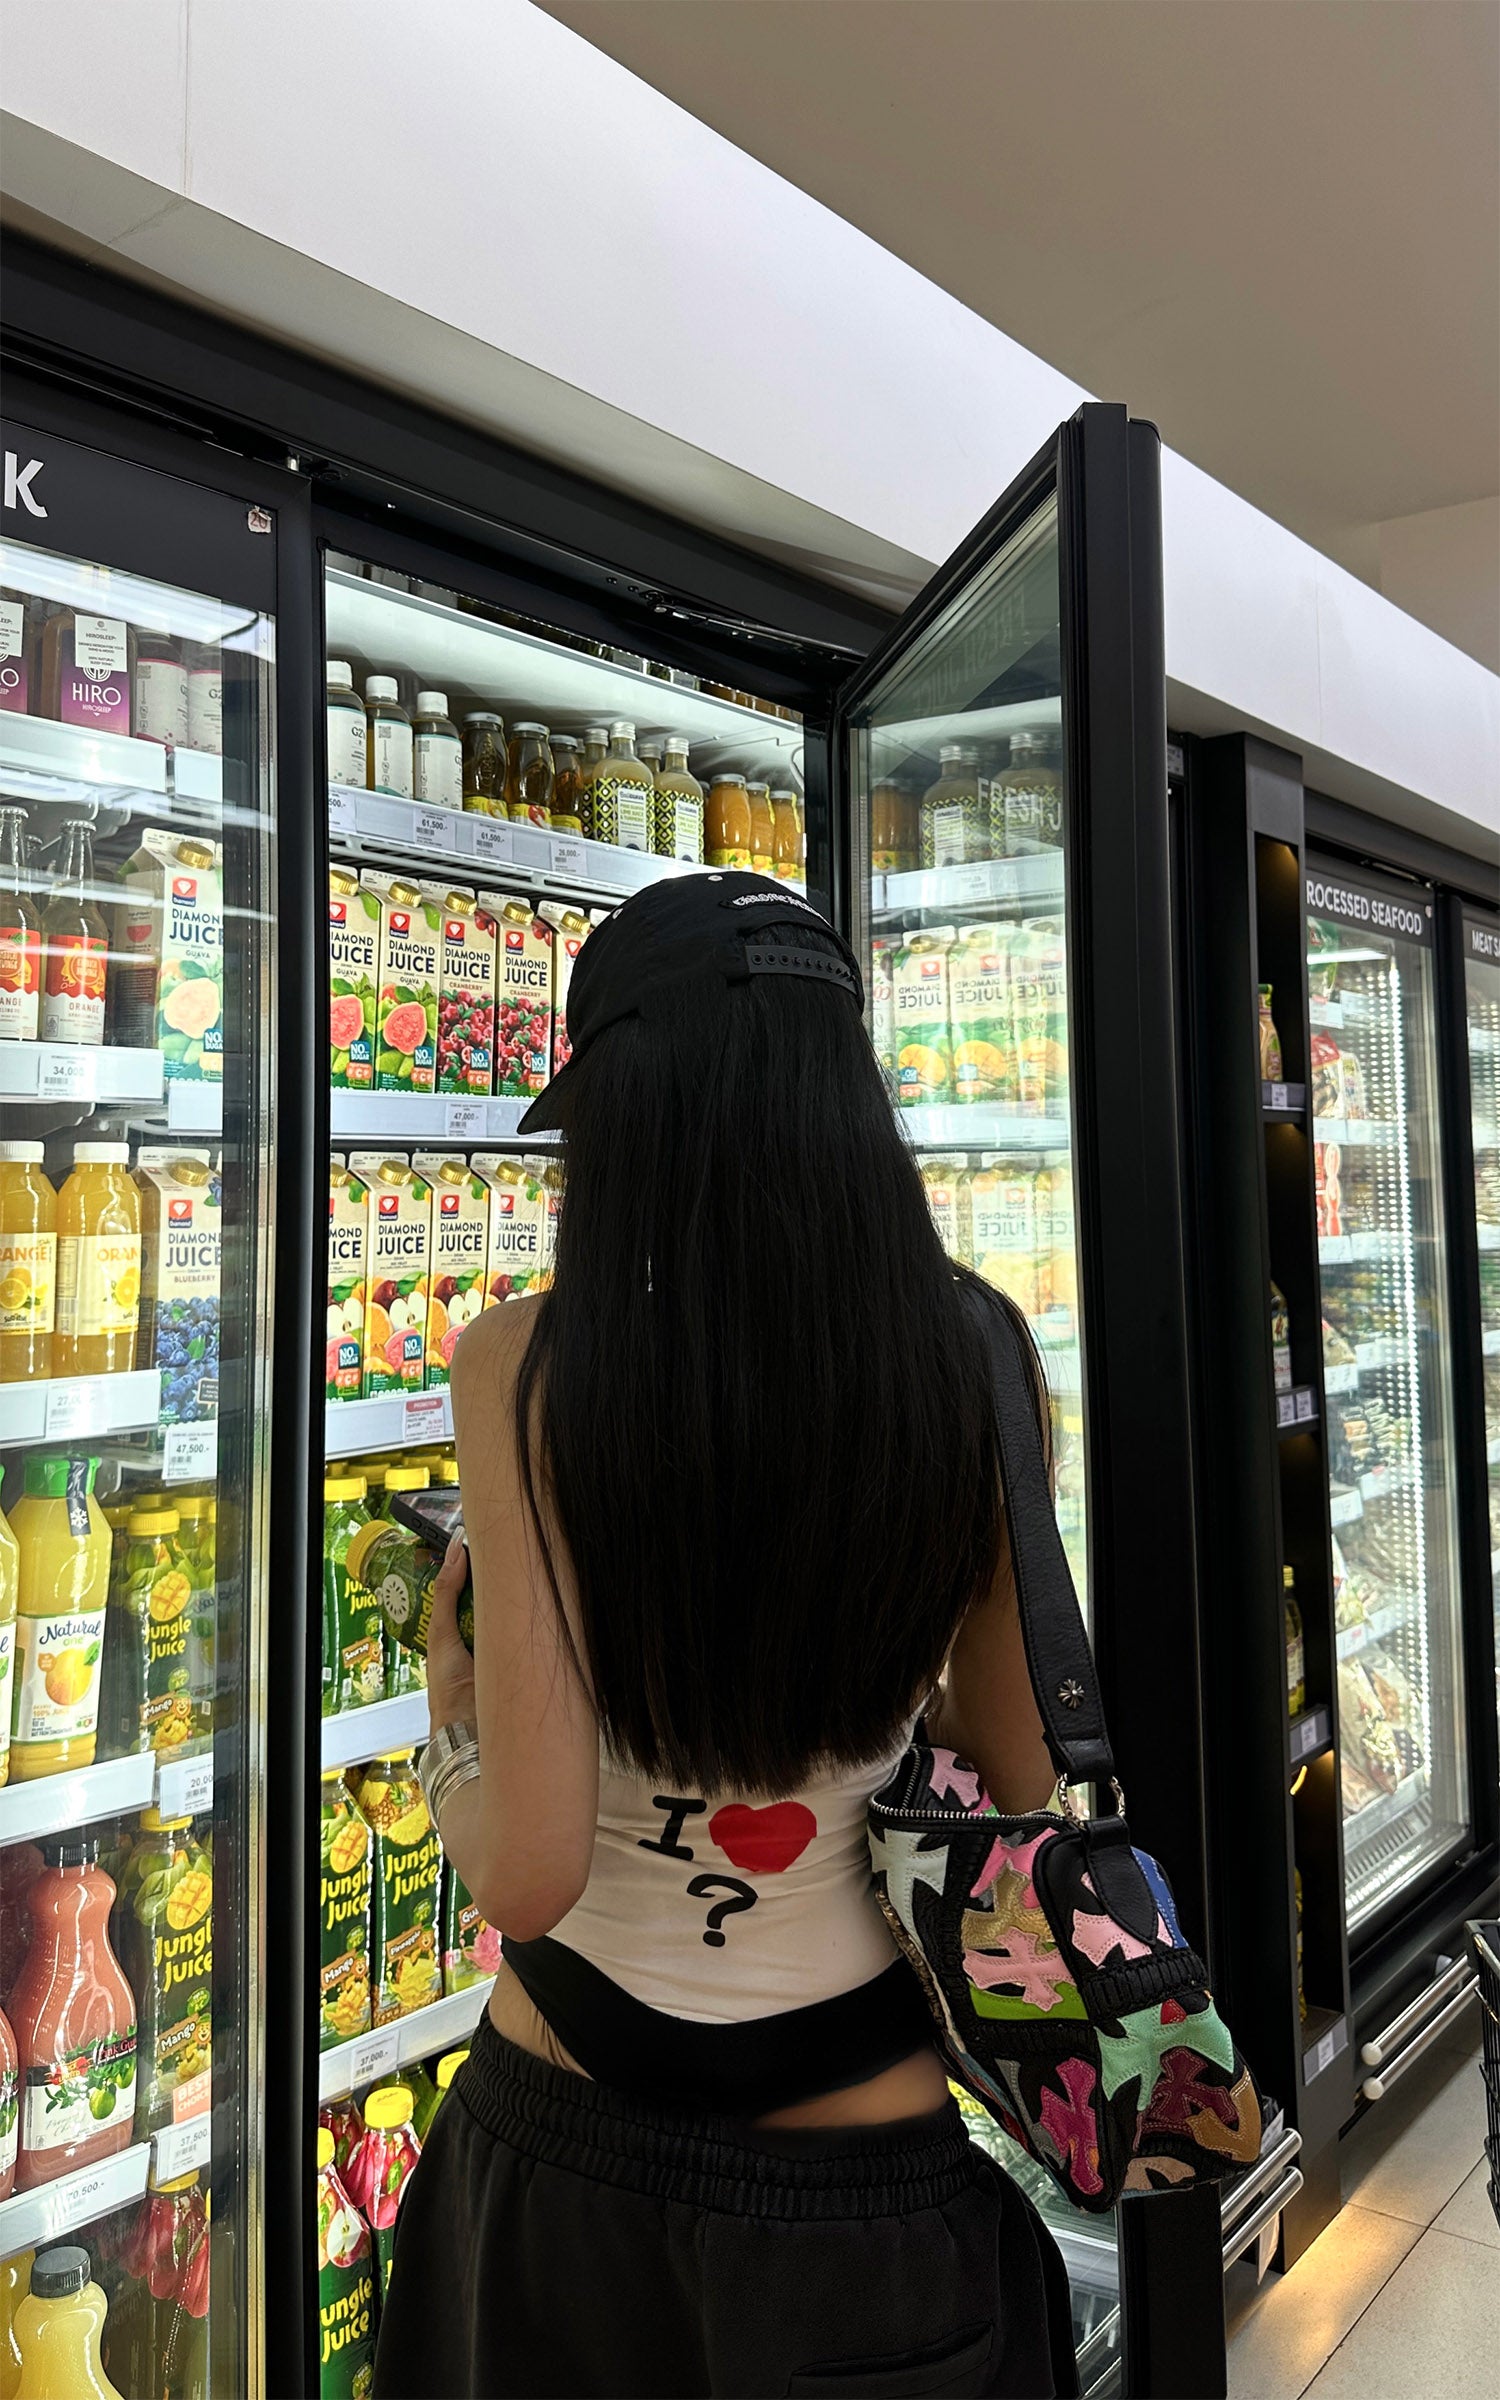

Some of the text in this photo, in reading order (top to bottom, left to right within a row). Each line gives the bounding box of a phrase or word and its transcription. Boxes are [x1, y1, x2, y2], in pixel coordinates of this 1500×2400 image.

[4, 451, 48, 518] K
[72, 682, 121, 706] HIRO
[82, 703, 112, 713] HIROSLEEP
[172, 908, 220, 925] DIAMON
[1306, 880, 1423, 936] ROCESSED SEAFOOD
[388, 940, 435, 956] DIAMOND
[1472, 929, 1493, 954] MEAT
[386, 951, 435, 974] JUICE
[445, 948, 490, 962] DIAMOND
[505, 956, 548, 970] DIAMOND
[336, 968, 358, 976] GUAVA
[443, 959, 490, 980] JUICE
[504, 968, 547, 987] JUICE
[400, 976, 420, 985] GUAVA
[449, 981, 483, 992] CRANBERRY
[509, 989, 541, 998] CRANBERRY
[69, 1002, 100, 1014] ORANGE
[350, 1043, 366, 1054] NO
[414, 1049, 429, 1060] NO
[471, 1052, 484, 1062] NO
[531, 1056, 544, 1066] NO
[378, 1224, 426, 1235] DIAMOND
[440, 1222, 483, 1232] DIAMOND
[498, 1222, 538, 1232] DIAMOND
[332, 1240, 362, 1260] ICE
[376, 1236, 424, 1256] JUICE
[438, 1234, 482, 1252] JUICE
[496, 1234, 536, 1252] JUICE
[0, 1246, 48, 1261] ANGE
[166, 1246, 222, 1268] JUICE
[174, 1274, 216, 1284] BLUEBERRY
[339, 1346, 354, 1360] NO
[404, 1338, 418, 1351] NO
[39, 1620, 101, 1645] Natural
[145, 1616, 192, 1644] Jungle
[150, 1638, 186, 1663] Juice
[144, 1698, 173, 1720] Mango
[637, 1795, 707, 1861] I
[384, 1837, 443, 1882] Jungle
[392, 1863, 438, 1905] Juice
[326, 1892, 370, 1931] Juice
[686, 1873, 758, 1947] ?
[154, 1917, 212, 1968] Jungl
[390, 1930, 422, 1956] Pineapple
[163, 1951, 212, 1993] Juice
[324, 1956, 354, 1984] Mango
[160, 2021, 196, 2052] Mango
[178, 2074, 209, 2102] BEST
[320, 2276, 373, 2327] ungle
[322, 2310, 370, 2363] Juice
